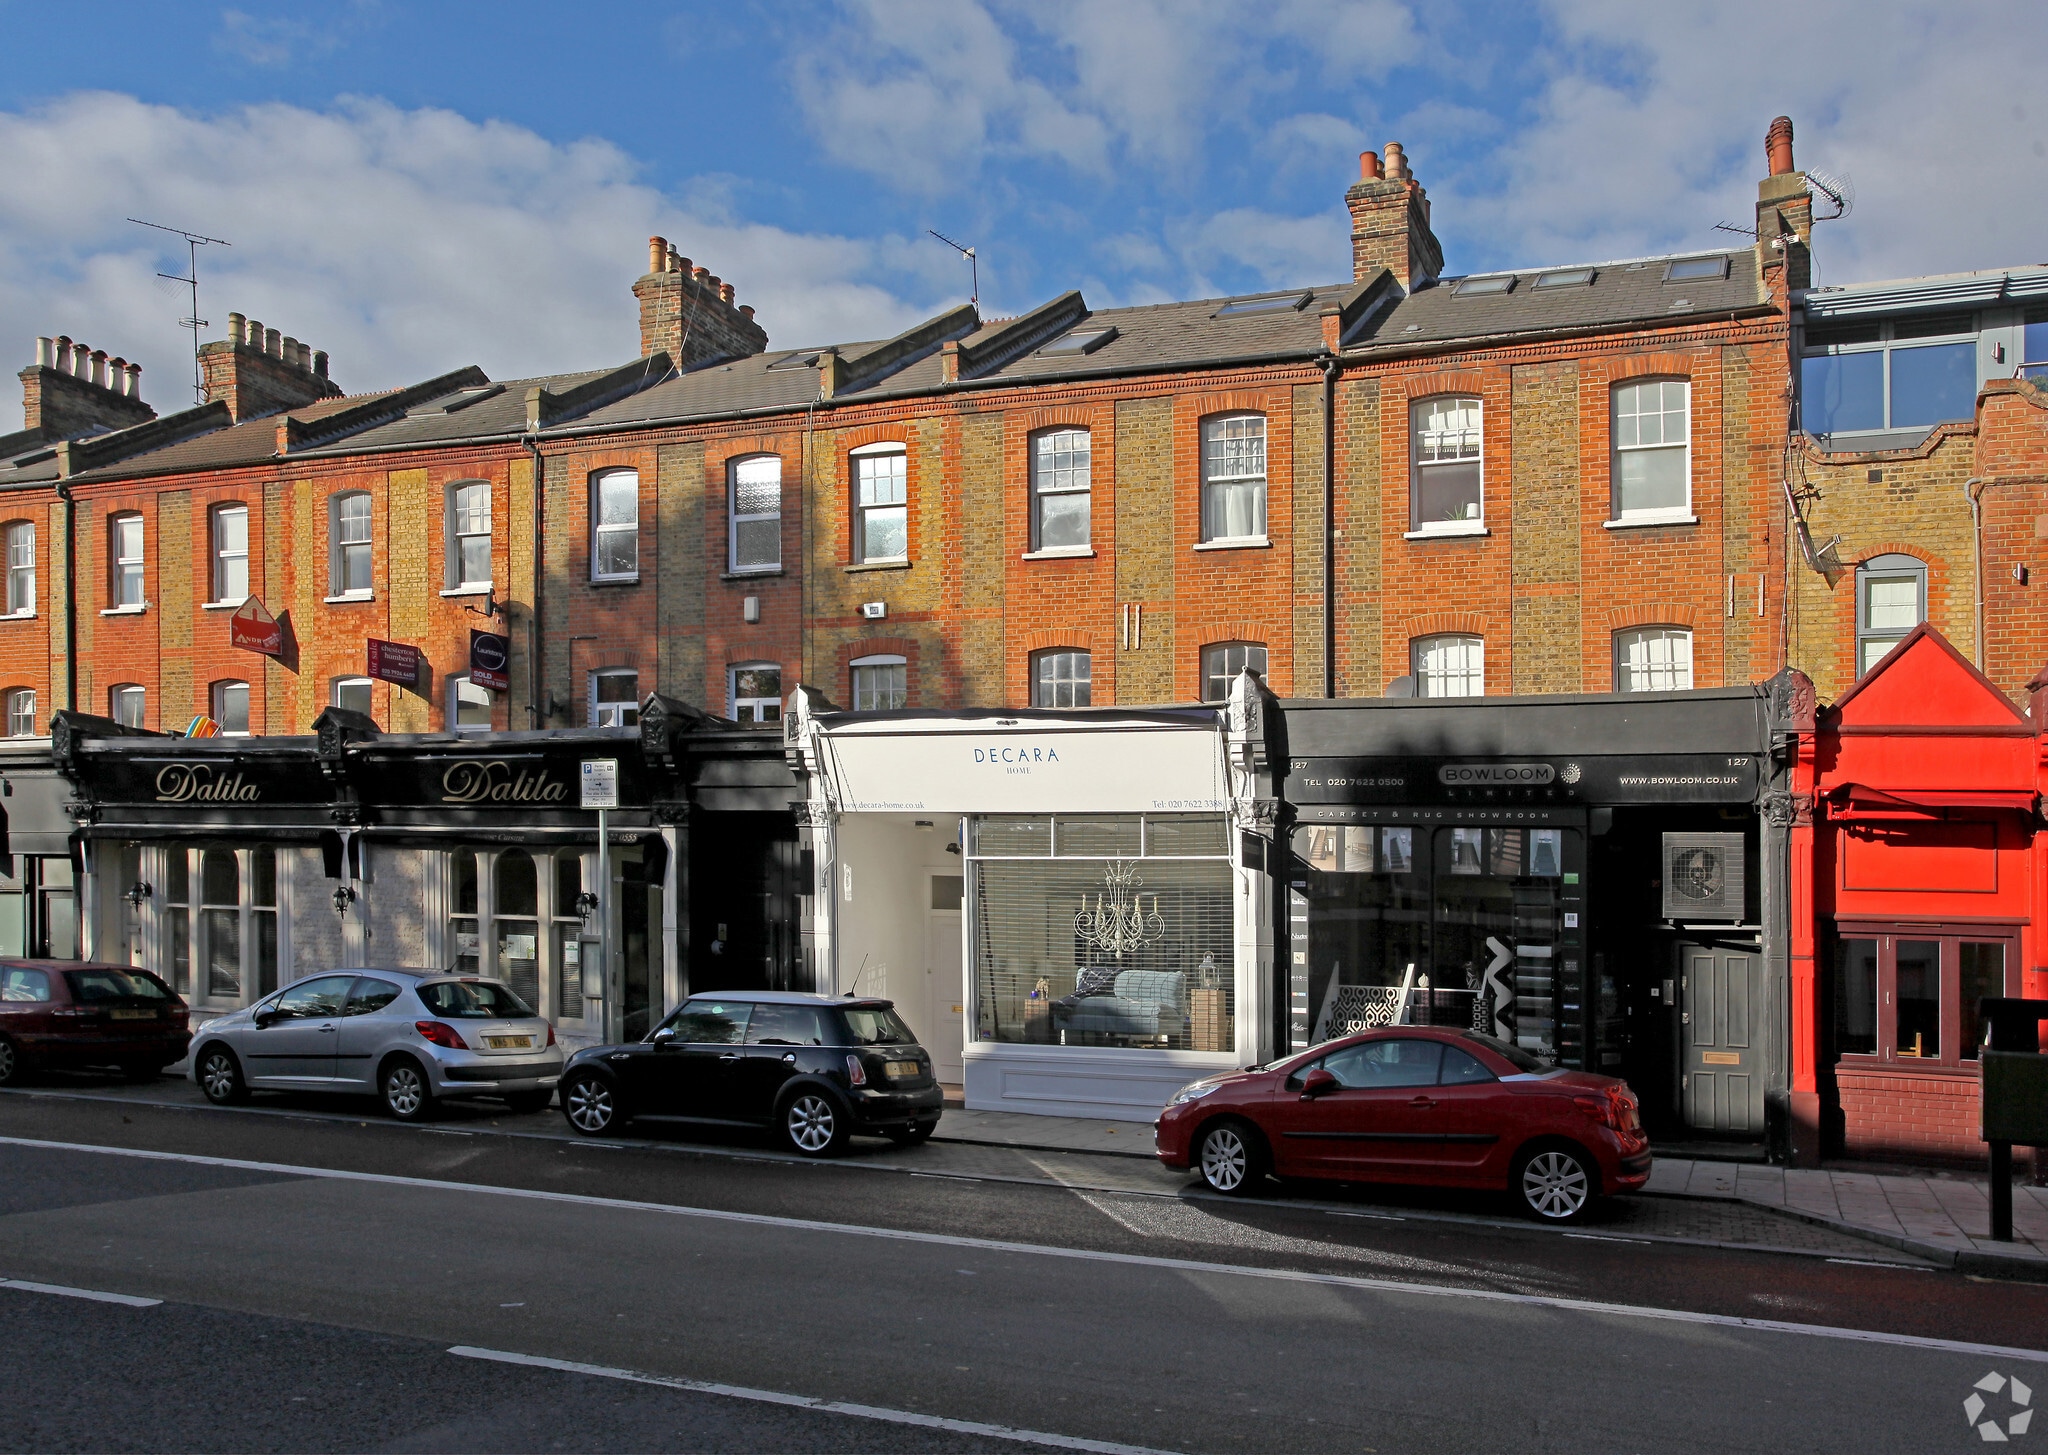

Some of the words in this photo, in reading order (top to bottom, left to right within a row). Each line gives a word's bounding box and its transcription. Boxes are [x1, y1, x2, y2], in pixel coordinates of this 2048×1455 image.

[369, 642, 377, 659] sale
[381, 645, 415, 656] chesterton
[384, 653, 415, 663] humberts
[474, 671, 492, 680] SOLD
[974, 748, 1059, 763] DECARA
[1727, 758, 1748, 766] 127
[1006, 767, 1032, 775] HOME
[1446, 769, 1548, 780] BOWLOOM
[156, 764, 260, 802] Dalila
[442, 761, 568, 802] Dalila
[1350, 778, 1375, 786] 7622
[1378, 778, 1404, 786] 0500
[1184, 800, 1202, 808] 7622
[619, 833, 638, 842] 0555
